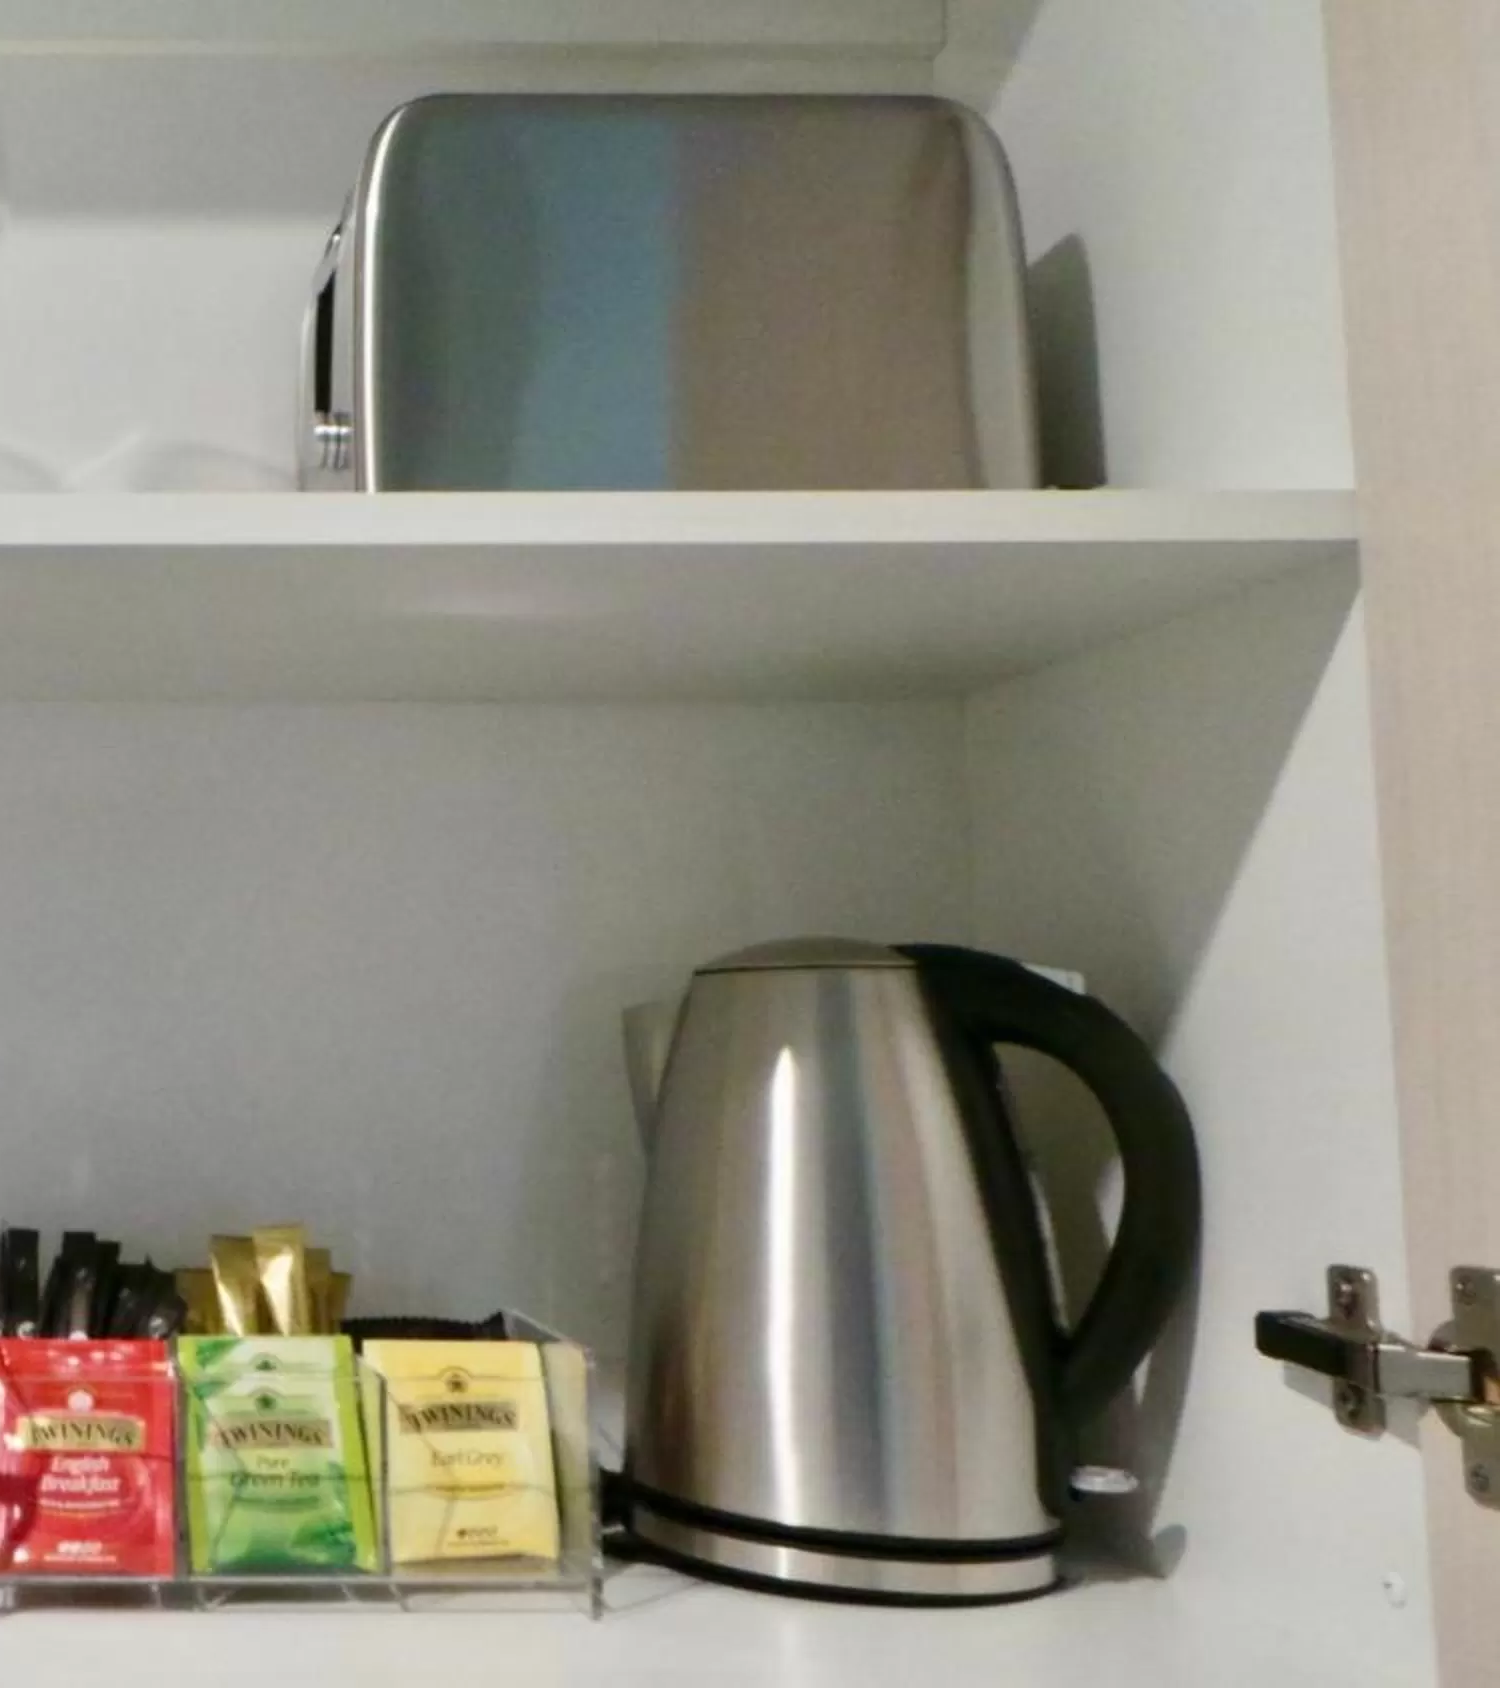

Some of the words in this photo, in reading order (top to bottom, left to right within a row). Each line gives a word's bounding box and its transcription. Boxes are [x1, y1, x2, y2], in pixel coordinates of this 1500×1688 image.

[405, 1402, 517, 1436] TWININGS
[28, 1420, 136, 1447] TWININGS
[214, 1422, 326, 1449] TWININGS
